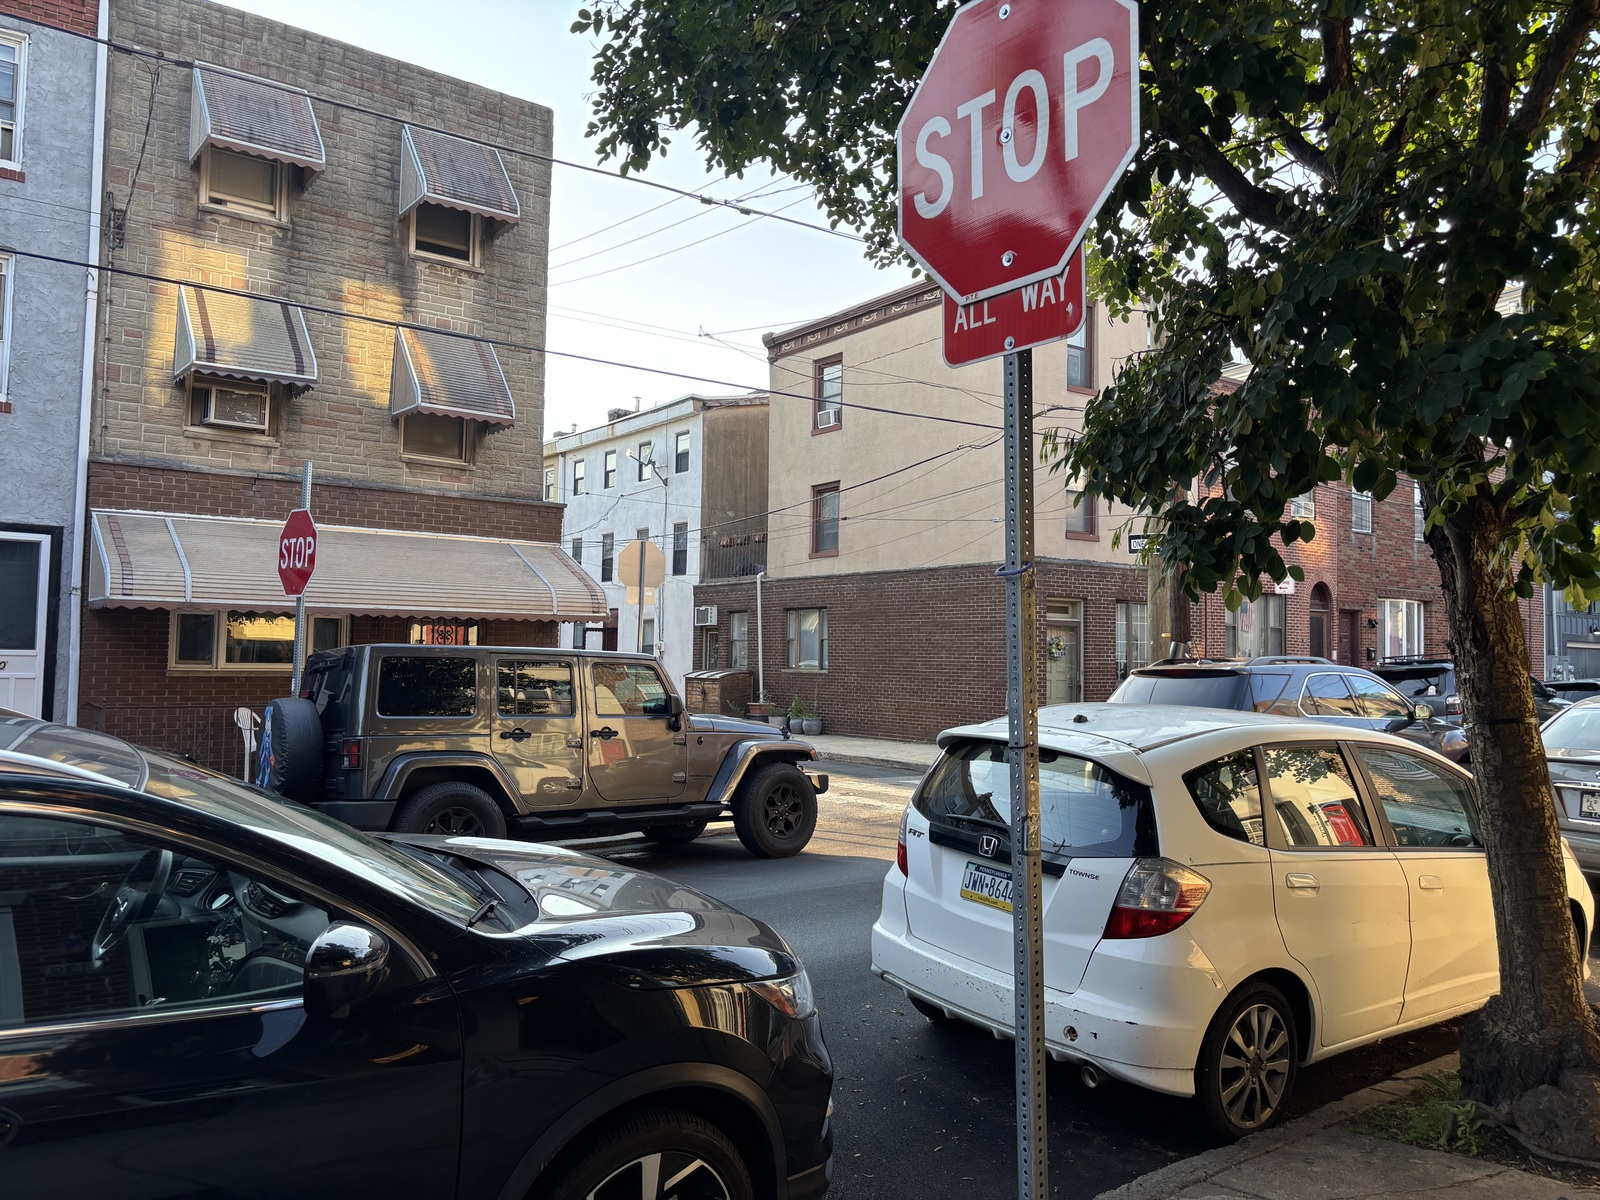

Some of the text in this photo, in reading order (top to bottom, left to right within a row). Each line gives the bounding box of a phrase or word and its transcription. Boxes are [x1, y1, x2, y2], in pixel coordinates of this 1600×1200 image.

[913, 37, 1115, 220] STOP
[953, 266, 1070, 334] ALL WAY
[281, 537, 314, 569] STOP
